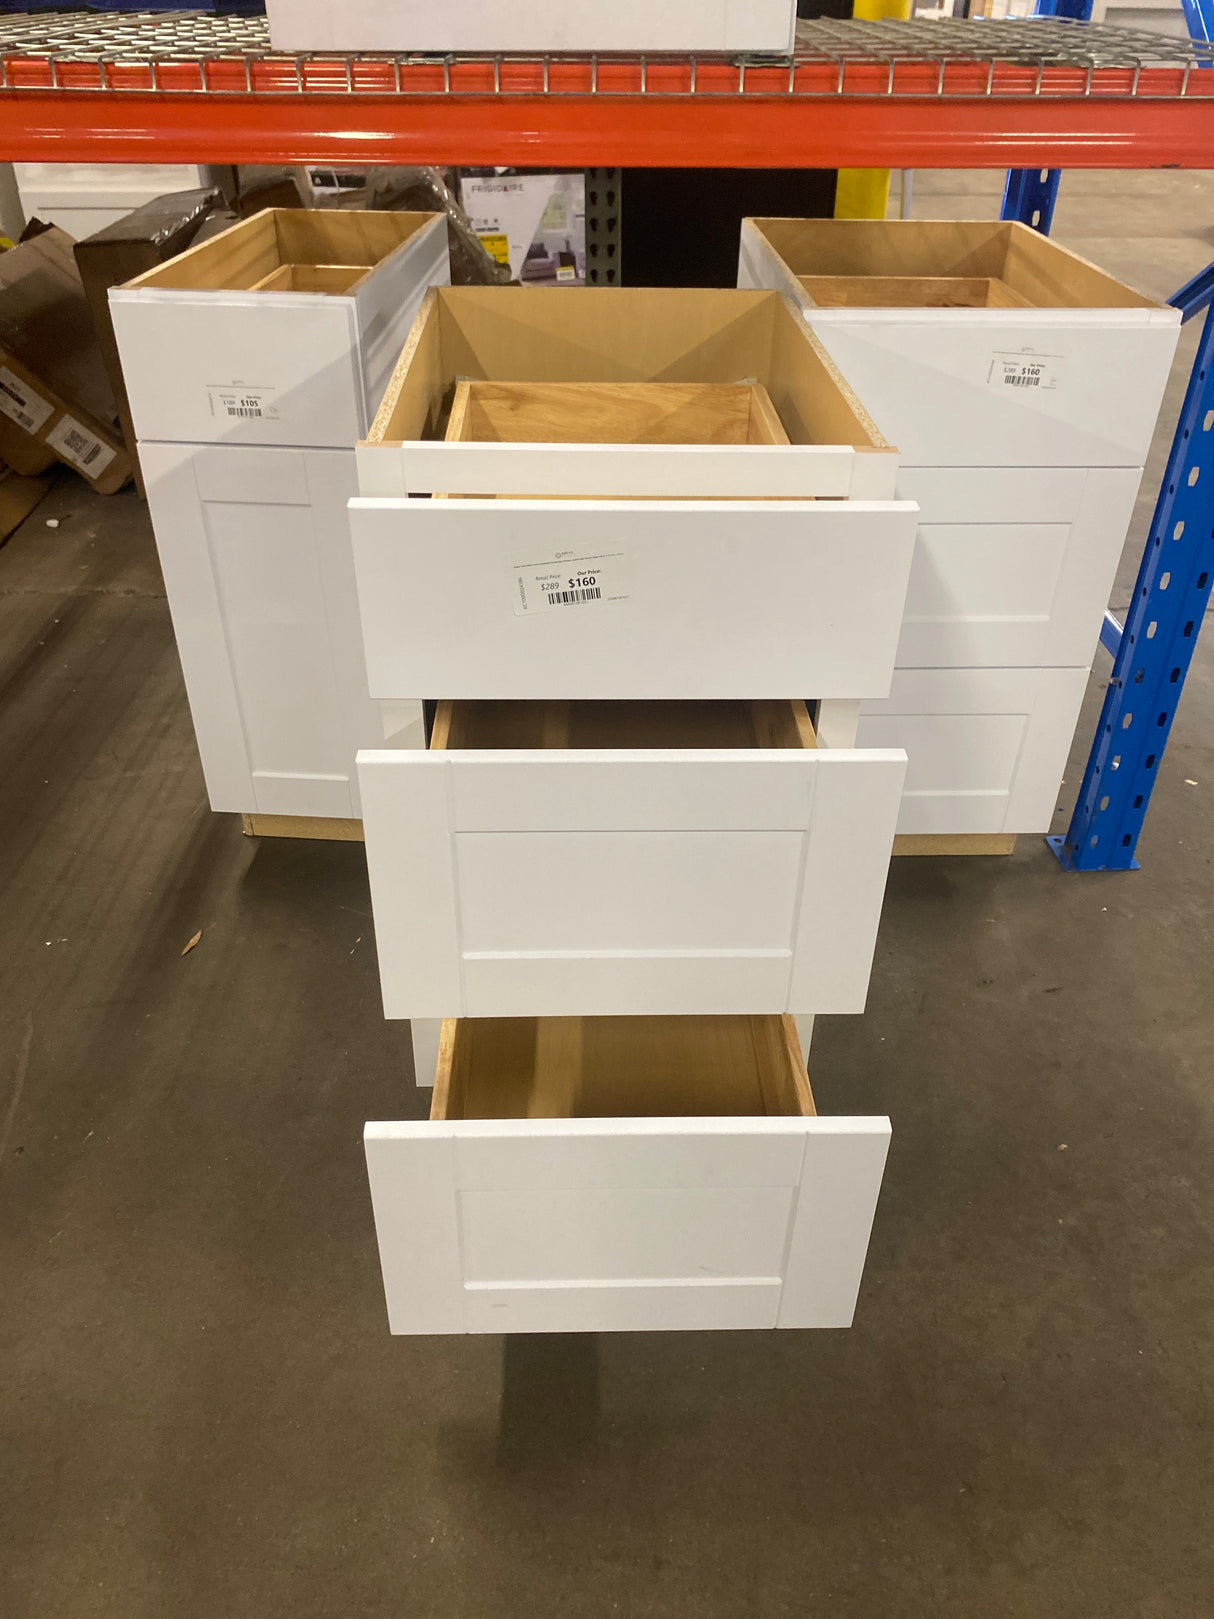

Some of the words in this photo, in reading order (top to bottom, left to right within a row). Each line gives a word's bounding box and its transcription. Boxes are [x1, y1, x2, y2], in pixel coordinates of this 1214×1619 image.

[472, 184, 524, 192] FRIGIDAIRE
[1022, 367, 1040, 375] $160
[568, 576, 596, 588] $160
[541, 582, 559, 591] $289
